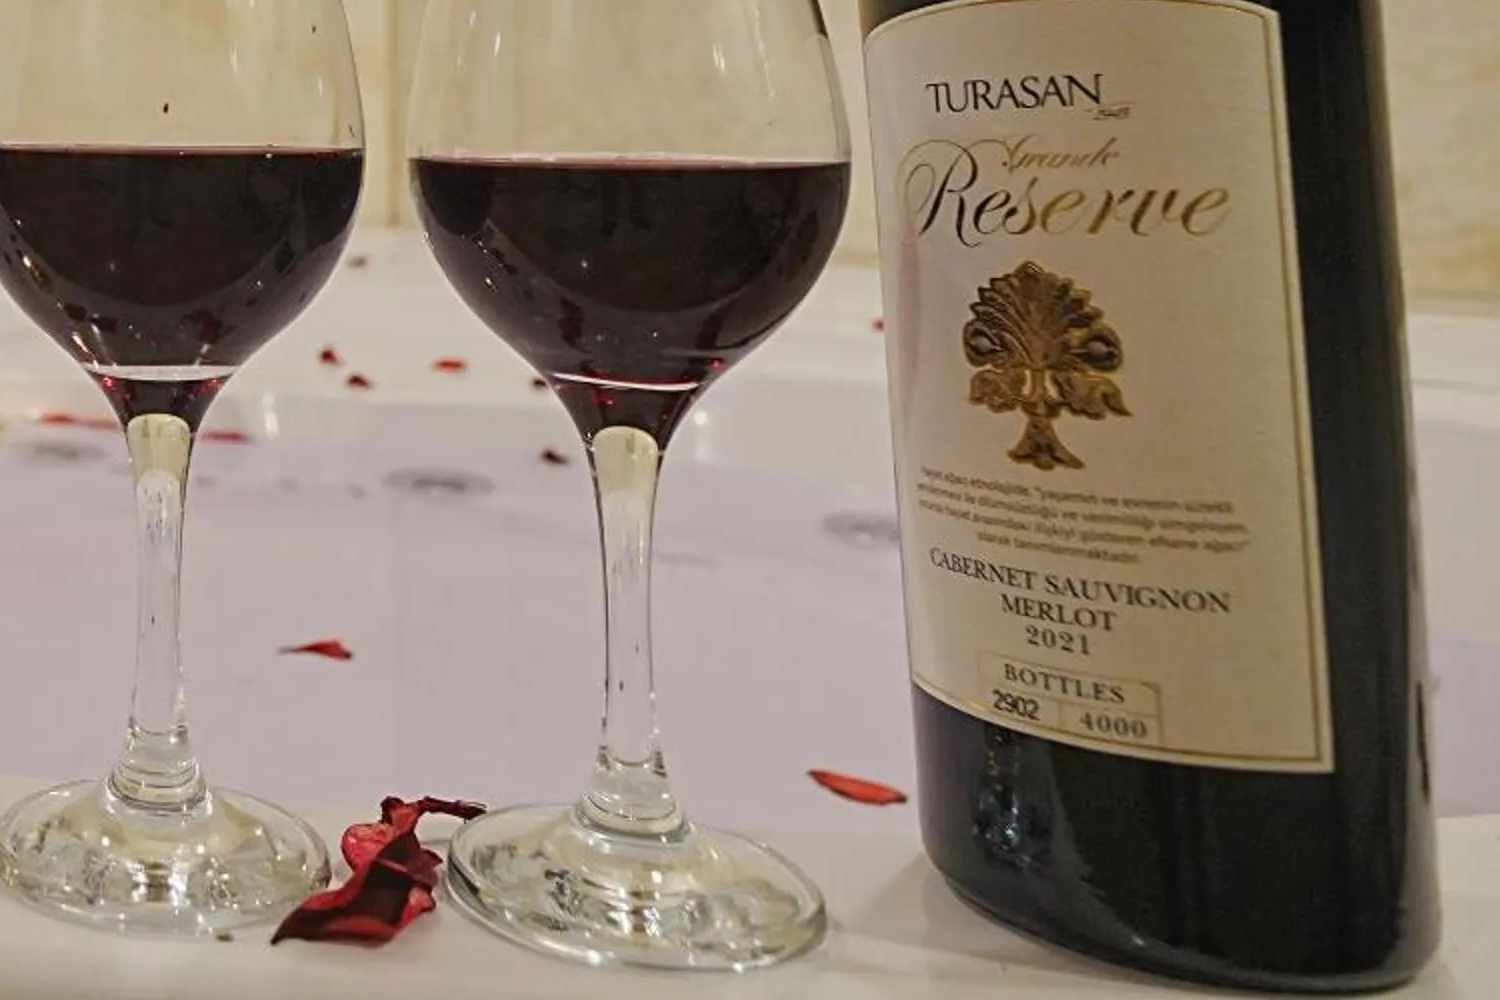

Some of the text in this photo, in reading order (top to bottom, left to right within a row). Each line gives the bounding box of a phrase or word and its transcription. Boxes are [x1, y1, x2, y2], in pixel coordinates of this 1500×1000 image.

[926, 73, 1103, 113] TURASAN
[900, 138, 1232, 249] Reserve
[930, 547, 1038, 591] CABERNET
[1044, 574, 1231, 614] SAUVIGNON
[1000, 593, 1119, 632] MERLOT
[1025, 624, 1092, 656] 2021
[1003, 663, 1126, 705] BOTTLES
[991, 688, 1149, 739] 2902 4000
